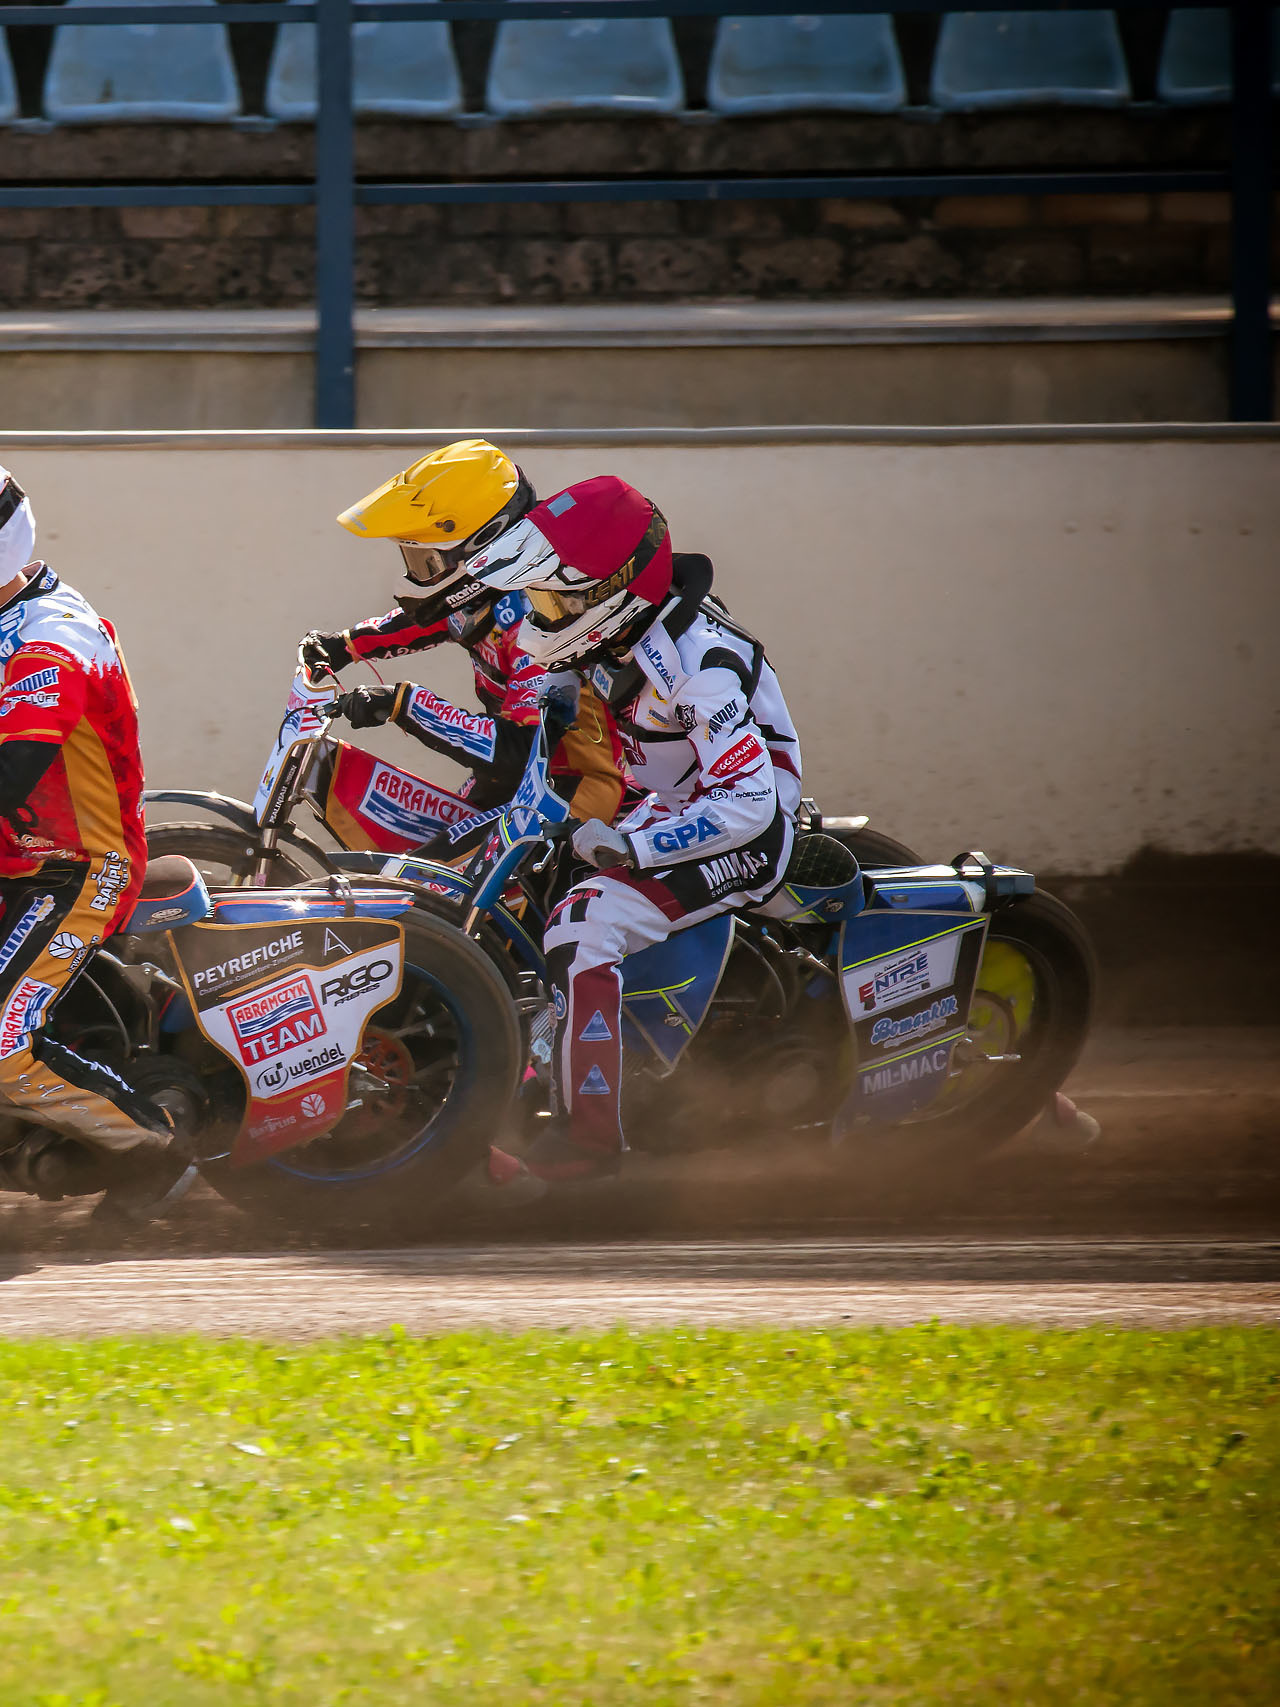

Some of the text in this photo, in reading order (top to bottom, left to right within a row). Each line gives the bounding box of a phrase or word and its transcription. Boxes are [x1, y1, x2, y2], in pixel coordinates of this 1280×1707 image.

[414, 688, 495, 739] ABRAMCZYK
[652, 815, 722, 854] GPA
[193, 930, 304, 989] PEYREFICHE
[320, 959, 394, 1006] RIGO
[858, 956, 929, 1004] ENTRE
[0, 982, 41, 1059] ABRAMCZYK
[235, 983, 307, 1024] ABRAMCZYK
[242, 1013, 324, 1061] TEAM
[289, 1043, 345, 1077] wendel
